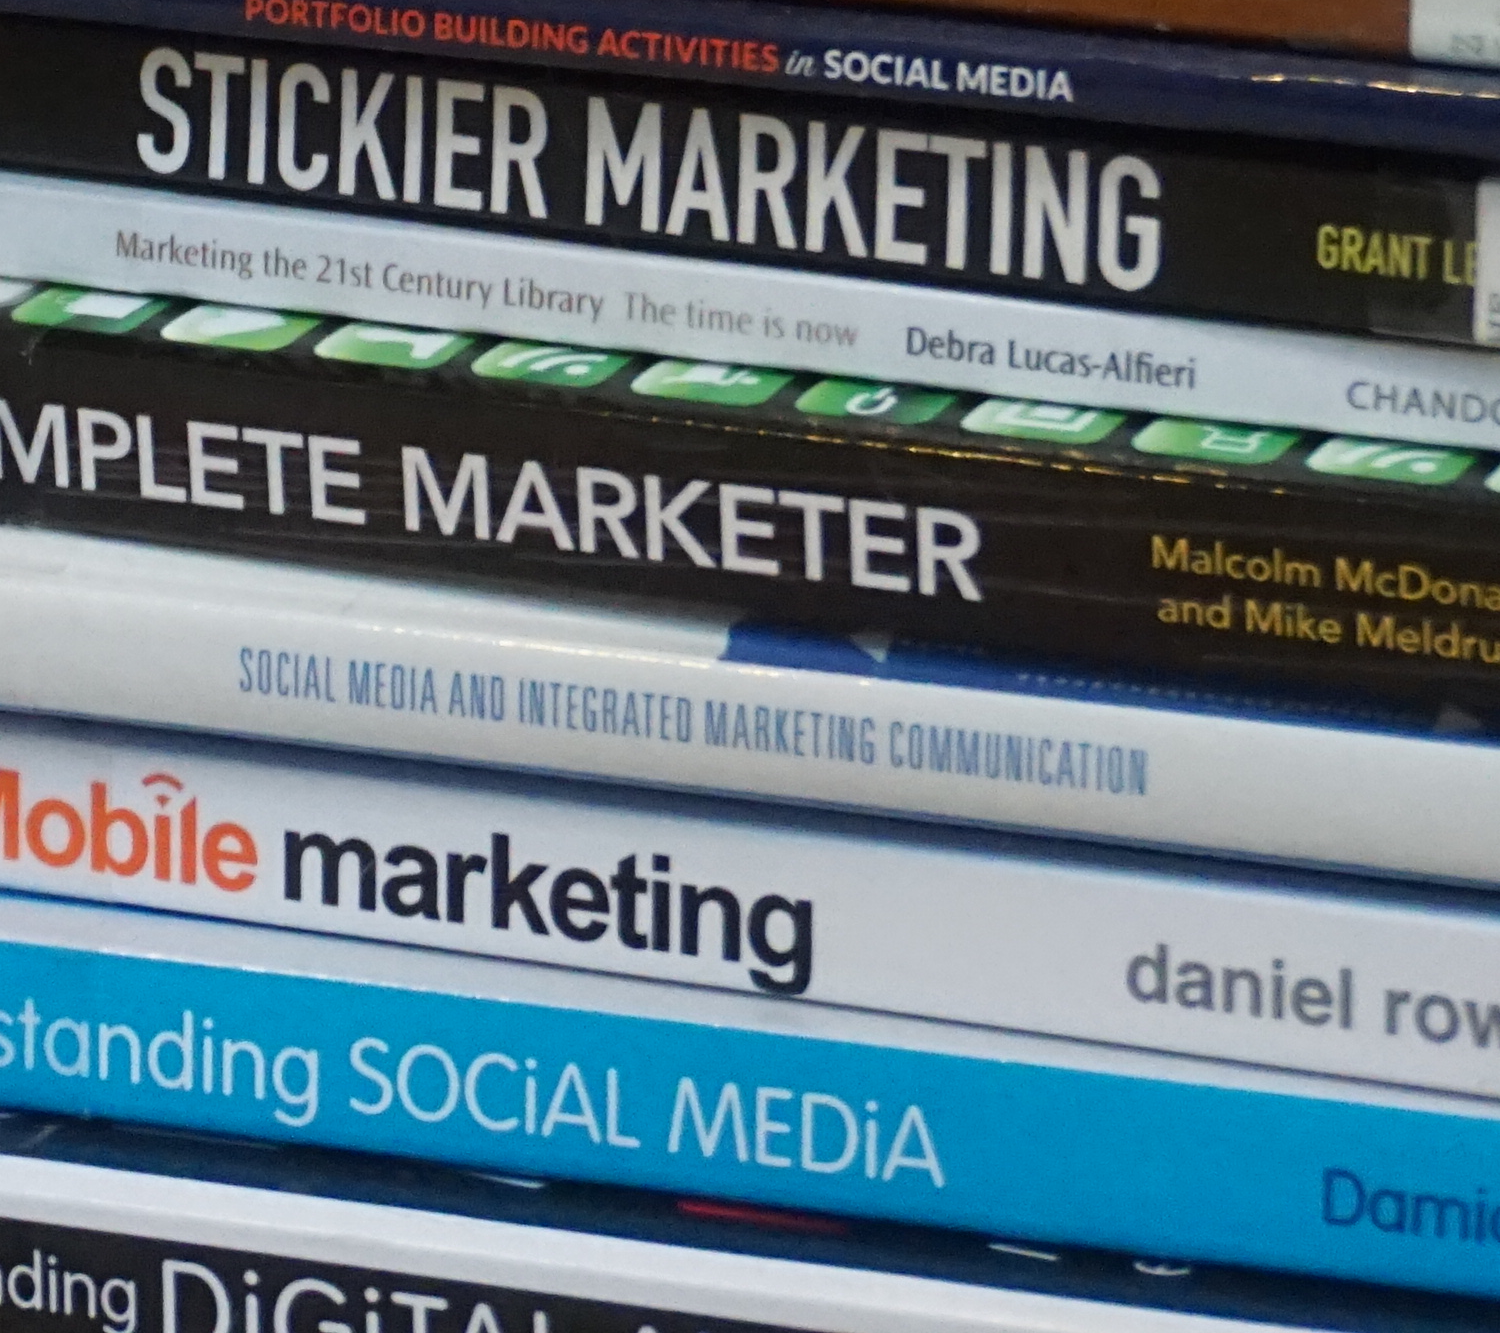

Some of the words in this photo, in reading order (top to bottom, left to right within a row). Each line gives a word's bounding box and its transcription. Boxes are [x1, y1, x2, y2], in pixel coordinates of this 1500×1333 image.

[435, 12, 588, 54] BUILDING
[598, 29, 778, 73] ACTIVITIES
[785, 50, 816, 76] in
[824, 49, 948, 91] SOCIAL
[957, 62, 1074, 103] MEDIA
[136, 47, 548, 220] STICKIER
[584, 95, 1162, 292] MARKETING
[116, 230, 253, 280] Marketing
[264, 248, 307, 281] the
[316, 255, 373, 290] 21st
[382, 263, 493, 310] Century
[504, 277, 604, 323] Library
[624, 292, 675, 327] The
[685, 300, 753, 338] time
[764, 312, 785, 341] is
[796, 317, 858, 348] now
[1316, 224, 1431, 280] GRANT
[906, 328, 995, 366] Debra
[1008, 338, 1196, 391] Lucas-Alfieri
[401, 446, 983, 602] MARKETER
[1151, 534, 1321, 588] Malcolm
[1158, 591, 1230, 631] and
[1246, 600, 1343, 645] Mike
[240, 647, 336, 703] SOCIAL
[349, 661, 438, 714] MEDIA
[449, 672, 505, 721] AND
[519, 677, 693, 744] INTEGRATED
[705, 700, 875, 765] MARKETING
[889, 720, 1147, 796] COMMUNICATION
[283, 830, 813, 996] marketing
[1127, 944, 1354, 1030] daniel
